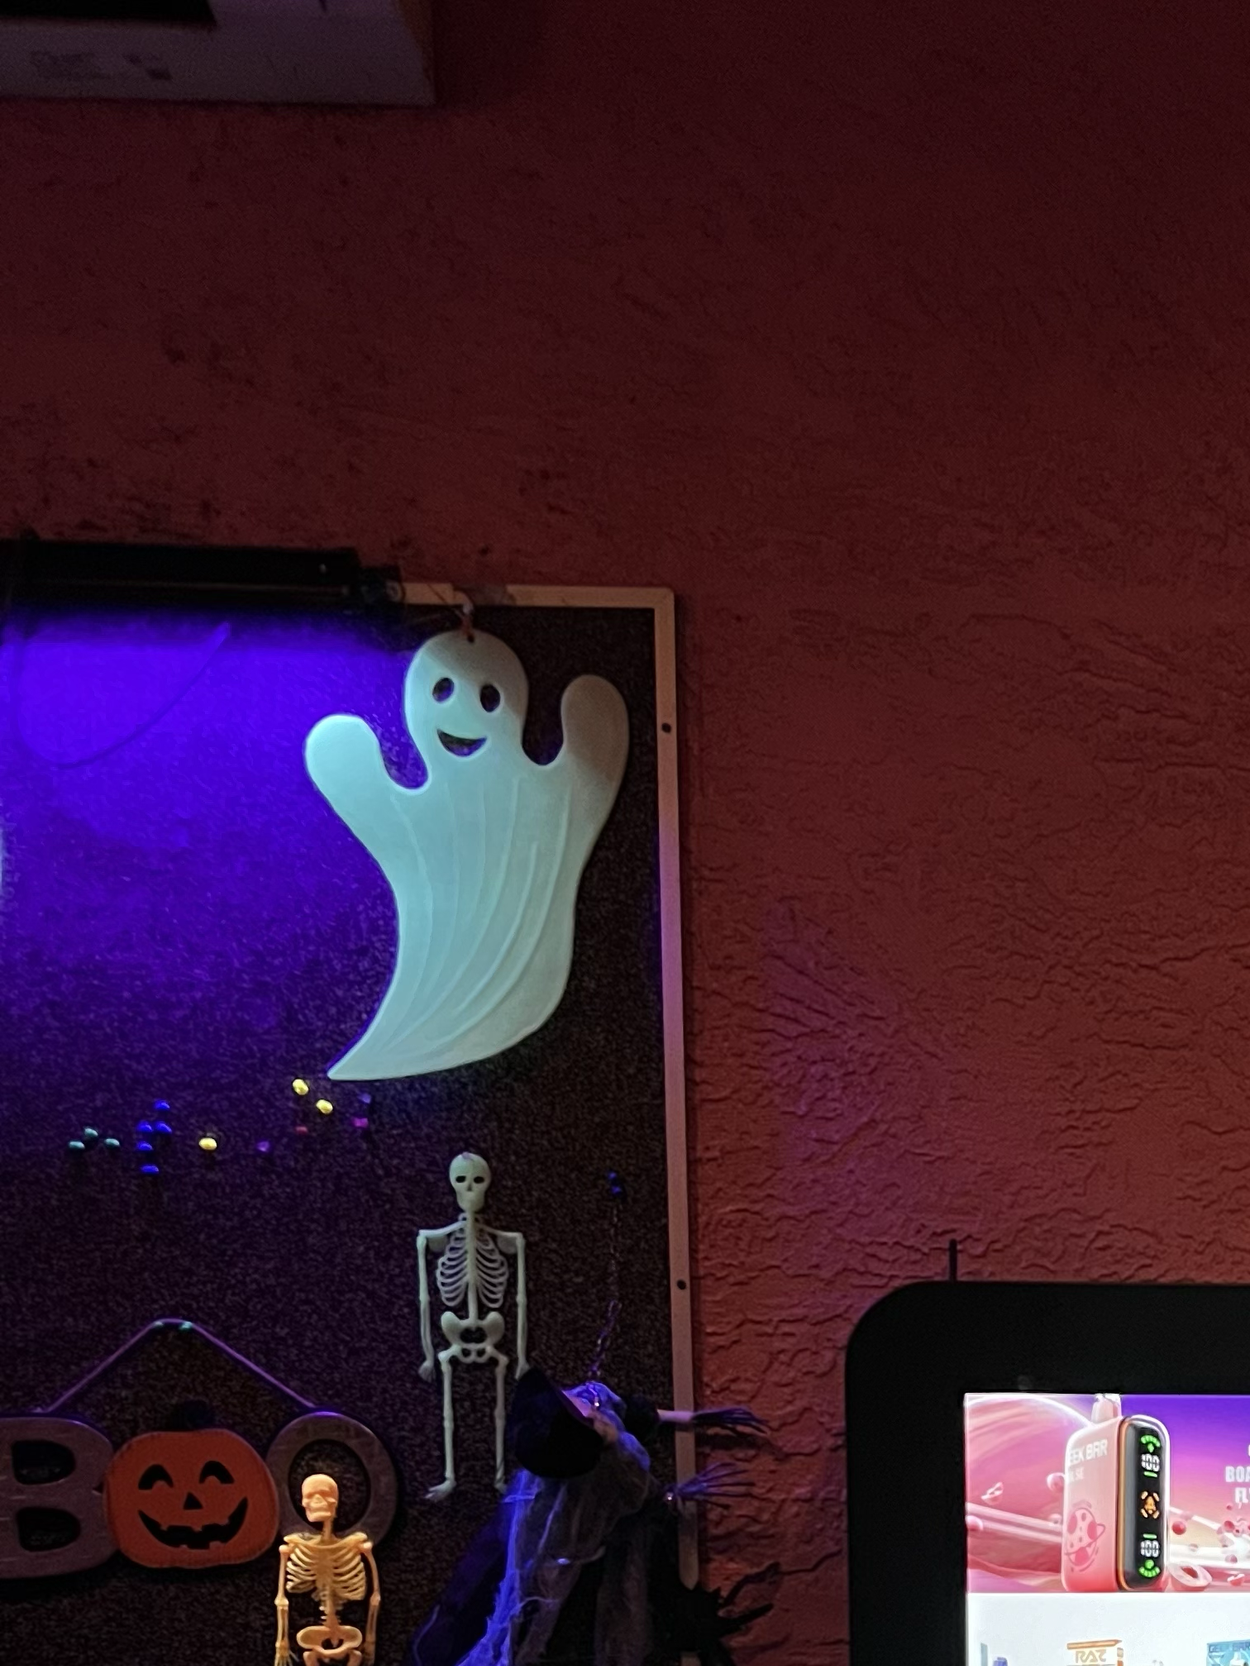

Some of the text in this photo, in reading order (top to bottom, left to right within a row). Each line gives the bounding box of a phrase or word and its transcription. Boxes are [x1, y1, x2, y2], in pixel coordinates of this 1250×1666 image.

[1086, 1438, 1108, 1461] BAR
[1141, 1453, 1160, 1472] 100
[1140, 1540, 1160, 1558] 100
[1075, 1649, 1107, 1664] RAZ
